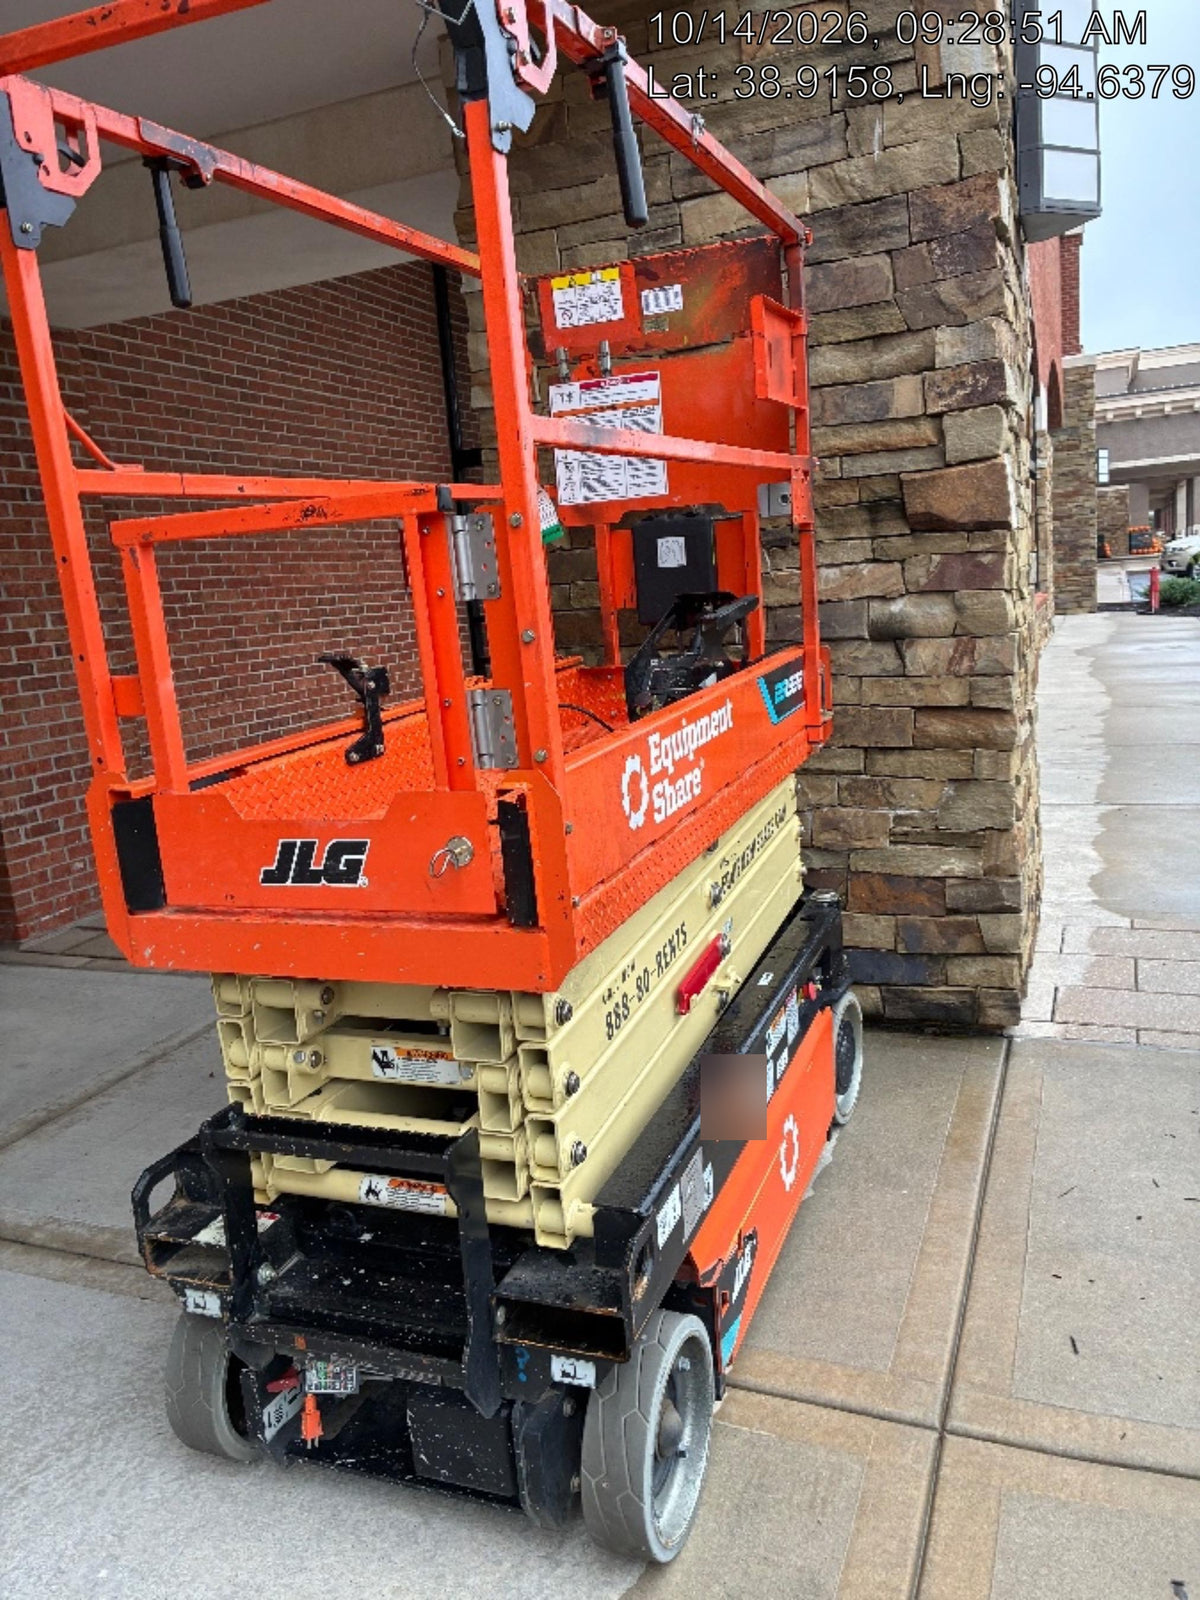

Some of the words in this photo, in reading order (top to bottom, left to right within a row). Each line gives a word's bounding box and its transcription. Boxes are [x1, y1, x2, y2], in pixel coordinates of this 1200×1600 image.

[648, 698, 734, 775] Equipment
[651, 765, 703, 825] Share
[259, 838, 371, 888] JLG
